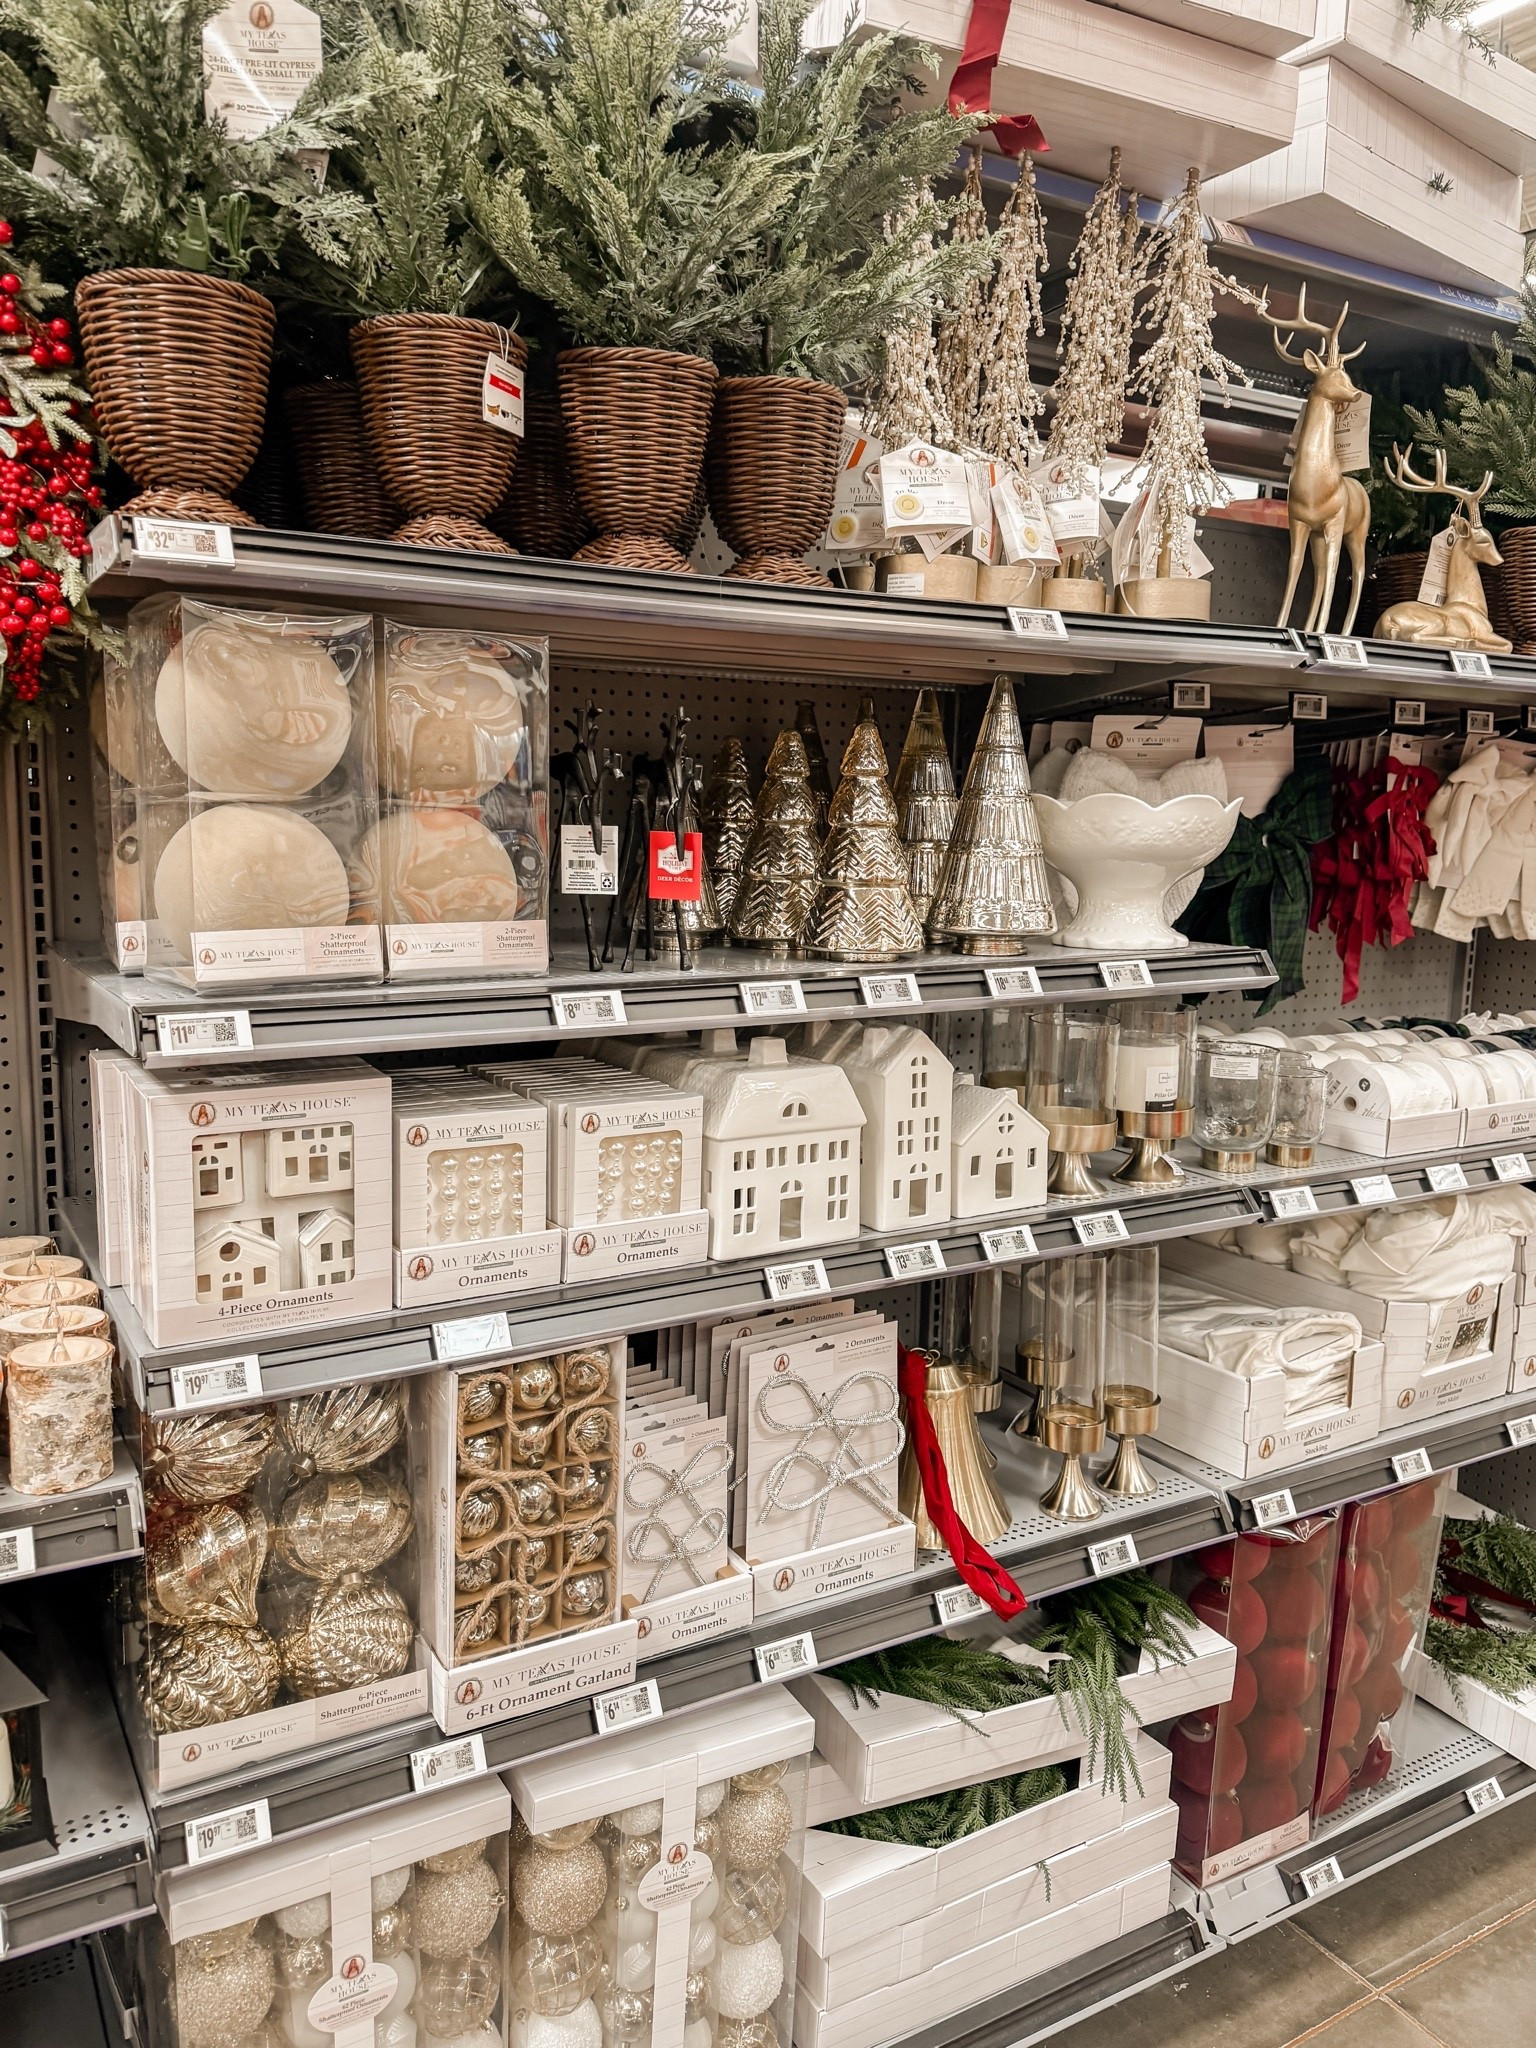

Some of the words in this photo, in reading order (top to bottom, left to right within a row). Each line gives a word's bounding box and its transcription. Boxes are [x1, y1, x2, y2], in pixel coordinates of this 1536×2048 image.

[240, 30, 256, 39] MY
[258, 30, 287, 40] TEXAS
[248, 40, 279, 49] HOUSE
[208, 56, 244, 66] 24-INH
[245, 59, 278, 69] PRE-LIT
[280, 60, 316, 70] CYPRESS
[211, 64, 264, 77] CHRISMAS
[265, 70, 295, 79] SMALL
[1337, 442, 1352, 450] Décor
[900, 469, 918, 477] MY
[919, 468, 951, 477] TEXAS
[909, 476, 944, 484] HOUSE
[320, 939, 368, 949] Shatterproof
[330, 933, 357, 941] 2-Piece
[496, 934, 536, 942] Shatterproof
[452, 941, 478, 949] HOUSE
[499, 941, 534, 949] Ornaments
[221, 952, 235, 960] MY
[236, 950, 265, 959] TEXAS
[268, 948, 299, 957] HOUSE
[225, 1106, 246, 1118] MY
[250, 1101, 298, 1116] TEXAS
[303, 1096, 352, 1111] HOUSE
[606, 1116, 622, 1126] MY
[624, 1112, 659, 1125] TEXAS
[662, 1108, 698, 1120] HOUSE
[436, 1128, 454, 1139] MY
[457, 1124, 497, 1138] TEXAS
[500, 1120, 541, 1133] HOUSE
[1512, 1126, 1530, 1134] Ribbon
[602, 1235, 620, 1246] MY
[624, 1229, 660, 1243] TEXAS
[663, 1222, 703, 1237] HOUSE
[441, 1256, 460, 1268] MY
[464, 1250, 506, 1266] TEXAS
[510, 1244, 555, 1260] HOUSE
[617, 1246, 679, 1264] Ornaments
[458, 1268, 528, 1287] Ornaments
[218, 1301, 263, 1318] 4-Piece
[266, 1290, 334, 1310] Ornaments
[222, 1316, 265, 1328] COORDINATES
[266, 1314, 281, 1322] WITH
[810, 1311, 844, 1323] Ornaments
[227, 1323, 268, 1333] COLLECTIONS
[850, 1334, 886, 1347] Ornaments
[1434, 1342, 1451, 1351] Skirt
[1420, 1390, 1429, 1399] MY
[1432, 1381, 1458, 1396] TEXAS
[1460, 1372, 1487, 1386] HOUSE
[676, 1414, 701, 1424] Ornaments
[695, 1428, 720, 1437] Ornaments
[1280, 1435, 1291, 1447] MY
[1294, 1426, 1324, 1442] TEXAS
[1326, 1416, 1357, 1433] HOUSE
[1305, 1444, 1328, 1456] Stocking
[801, 1568, 817, 1579] MY
[820, 1556, 856, 1574] TEXAS
[860, 1544, 898, 1562] HOUSE
[815, 1570, 874, 1594] Ornaments
[658, 1616, 673, 1627] MY
[675, 1606, 710, 1624] TEXAS
[712, 1593, 749, 1613] HOUSE
[672, 1616, 728, 1640] Ornaments
[492, 1674, 514, 1691] MY
[518, 1660, 566, 1682] TEXAS
[571, 1642, 622, 1668] HOUSE
[358, 1688, 388, 1702] 6-Piece
[466, 1703, 495, 1721] 6-Ft
[498, 1684, 571, 1711] Ornament
[576, 1662, 632, 1688] Garland
[320, 1700, 375, 1720] Shatterproof
[376, 1687, 422, 1706] Ornaments
[206, 1741, 223, 1753] MY
[224, 1733, 257, 1749] TEXAS
[259, 1724, 294, 1740] HOUSE
[646, 1890, 677, 1903] Shatterproof
[678, 1880, 705, 1893] Ornaments
[672, 1882, 686, 1890] Piece
[330, 1984, 344, 1994] MY
[347, 1973, 377, 1989] TEXAS
[338, 1984, 370, 1999] HOUSE
[318, 2006, 356, 2024] Shatterproof
[356, 1994, 389, 2009] Ornaments
[351, 1998, 366, 2007] Piece
